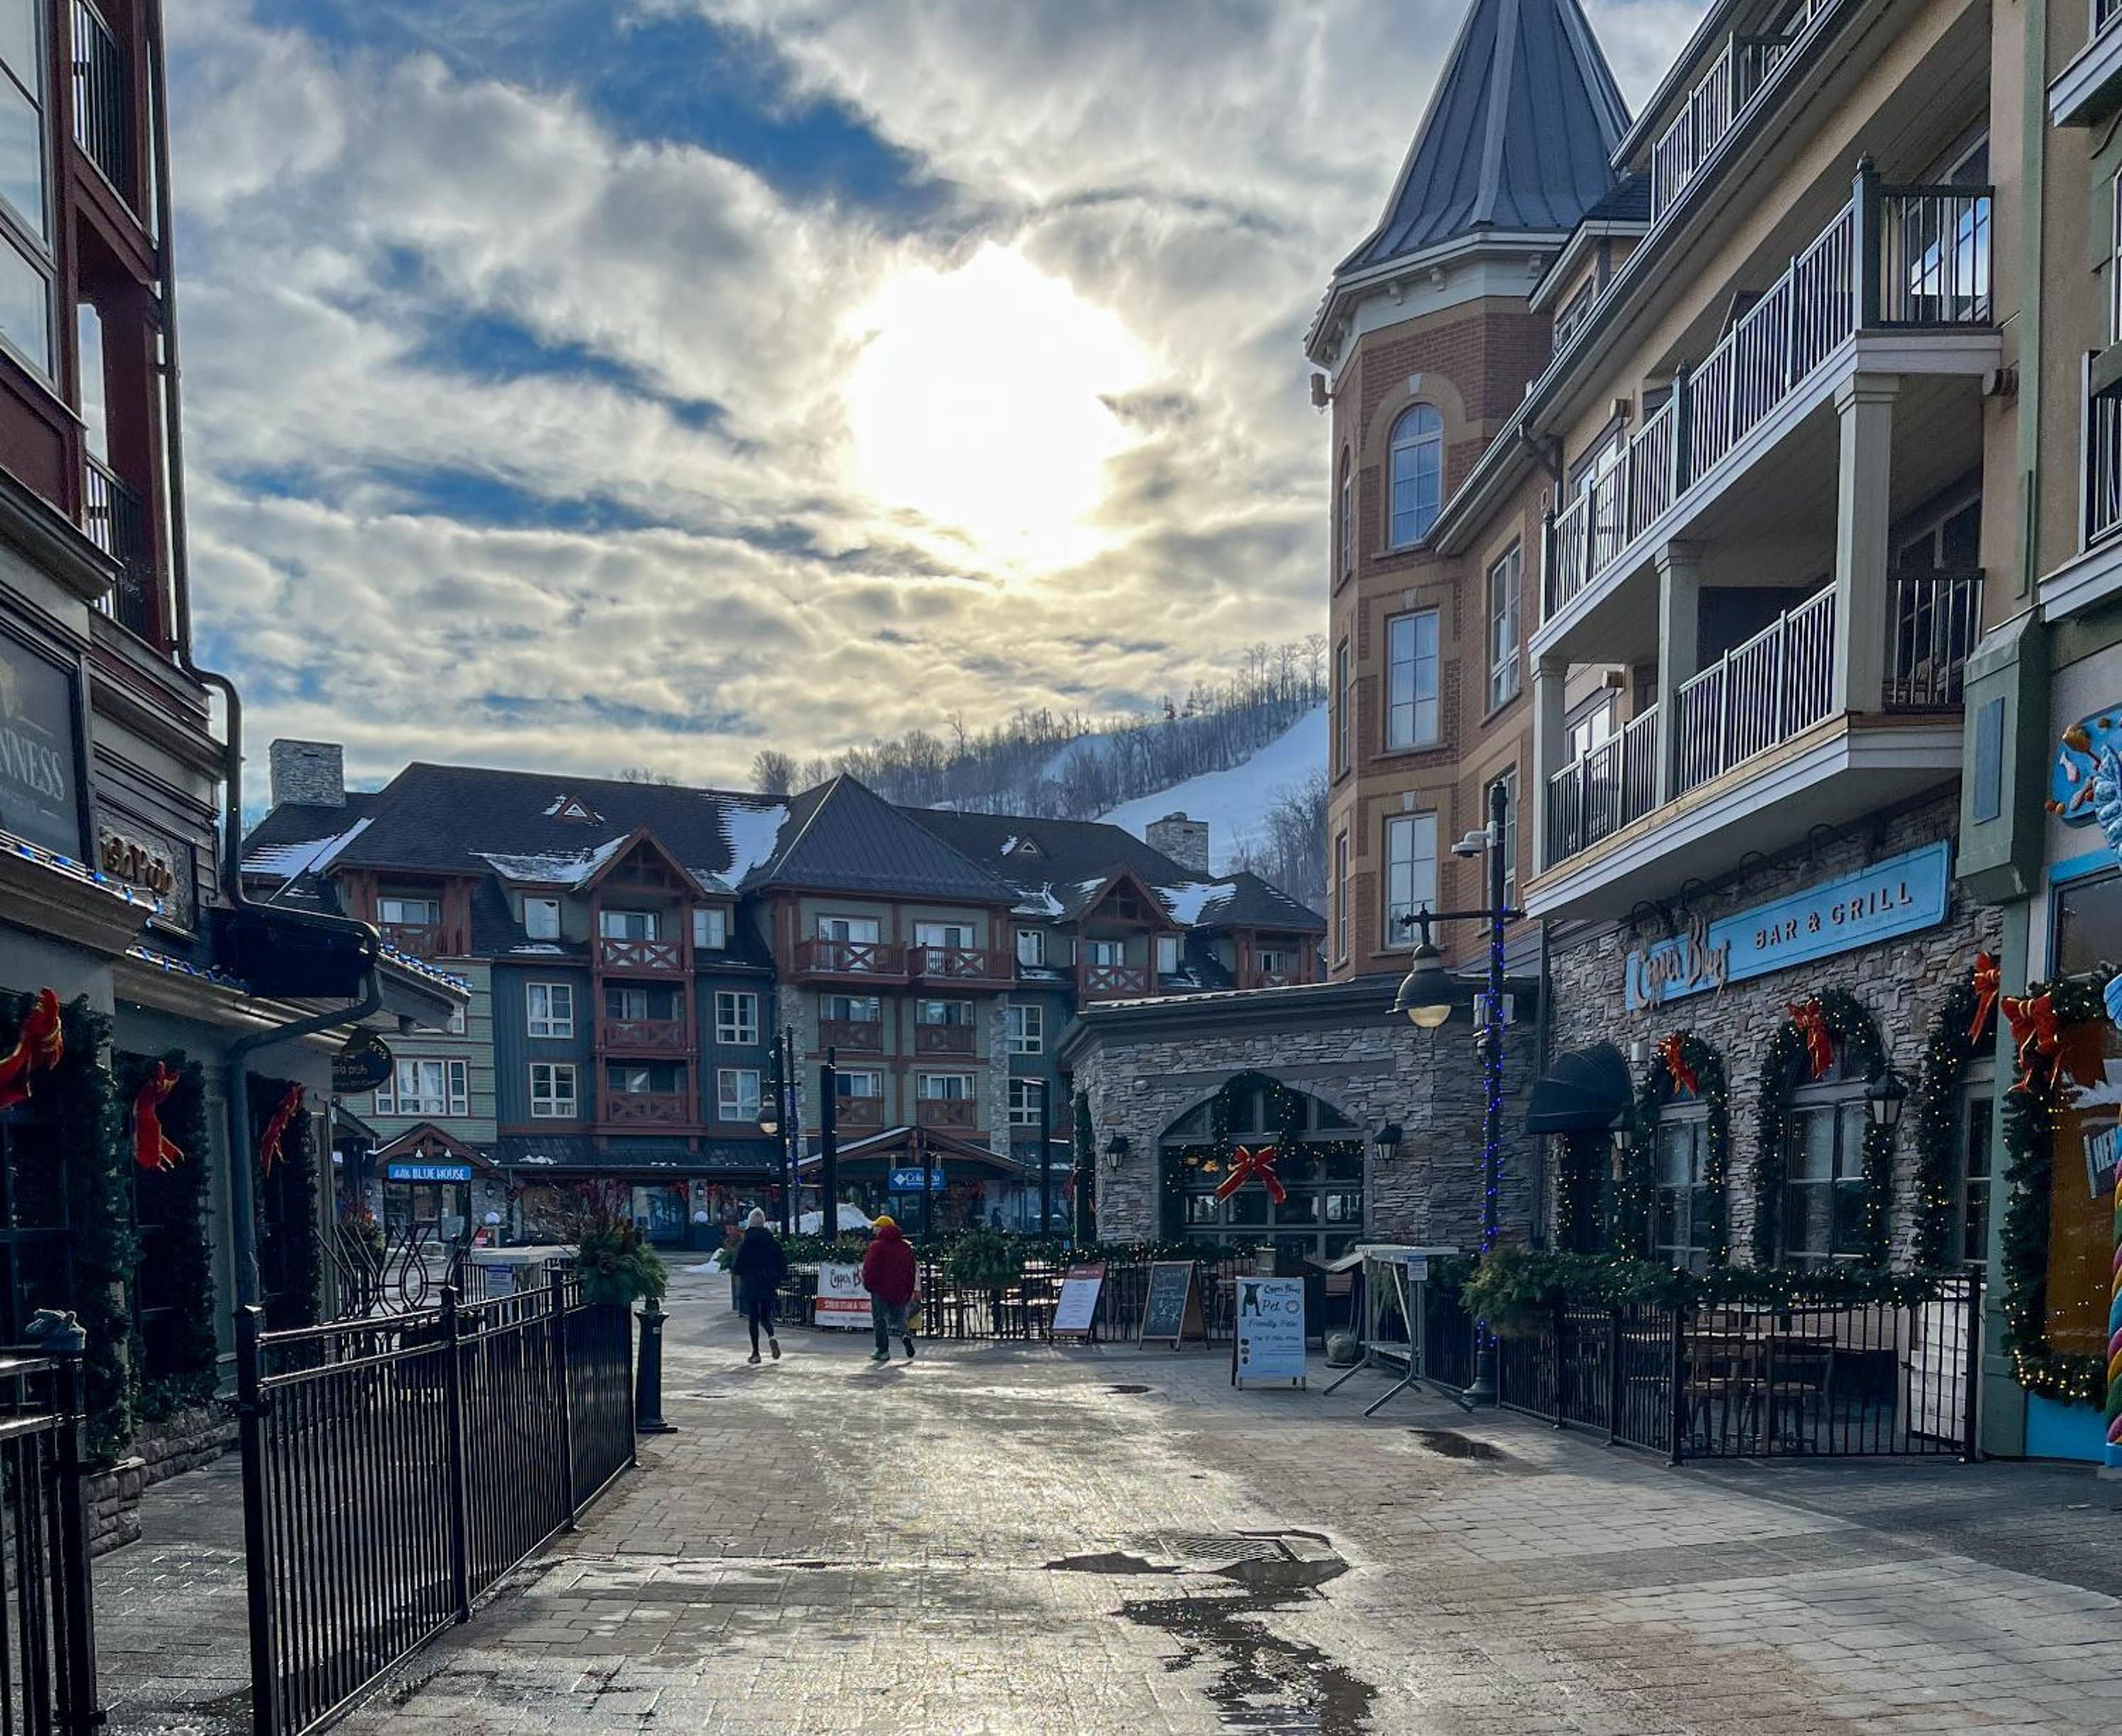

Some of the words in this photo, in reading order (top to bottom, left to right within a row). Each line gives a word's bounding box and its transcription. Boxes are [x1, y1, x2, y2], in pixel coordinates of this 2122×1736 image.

[1754, 918, 1798, 950] BAR
[1808, 911, 1821, 933] &
[1832, 882, 1913, 926] GRILL
[413, 1168, 435, 1180] BLUE
[436, 1168, 465, 1180] HOUSE
